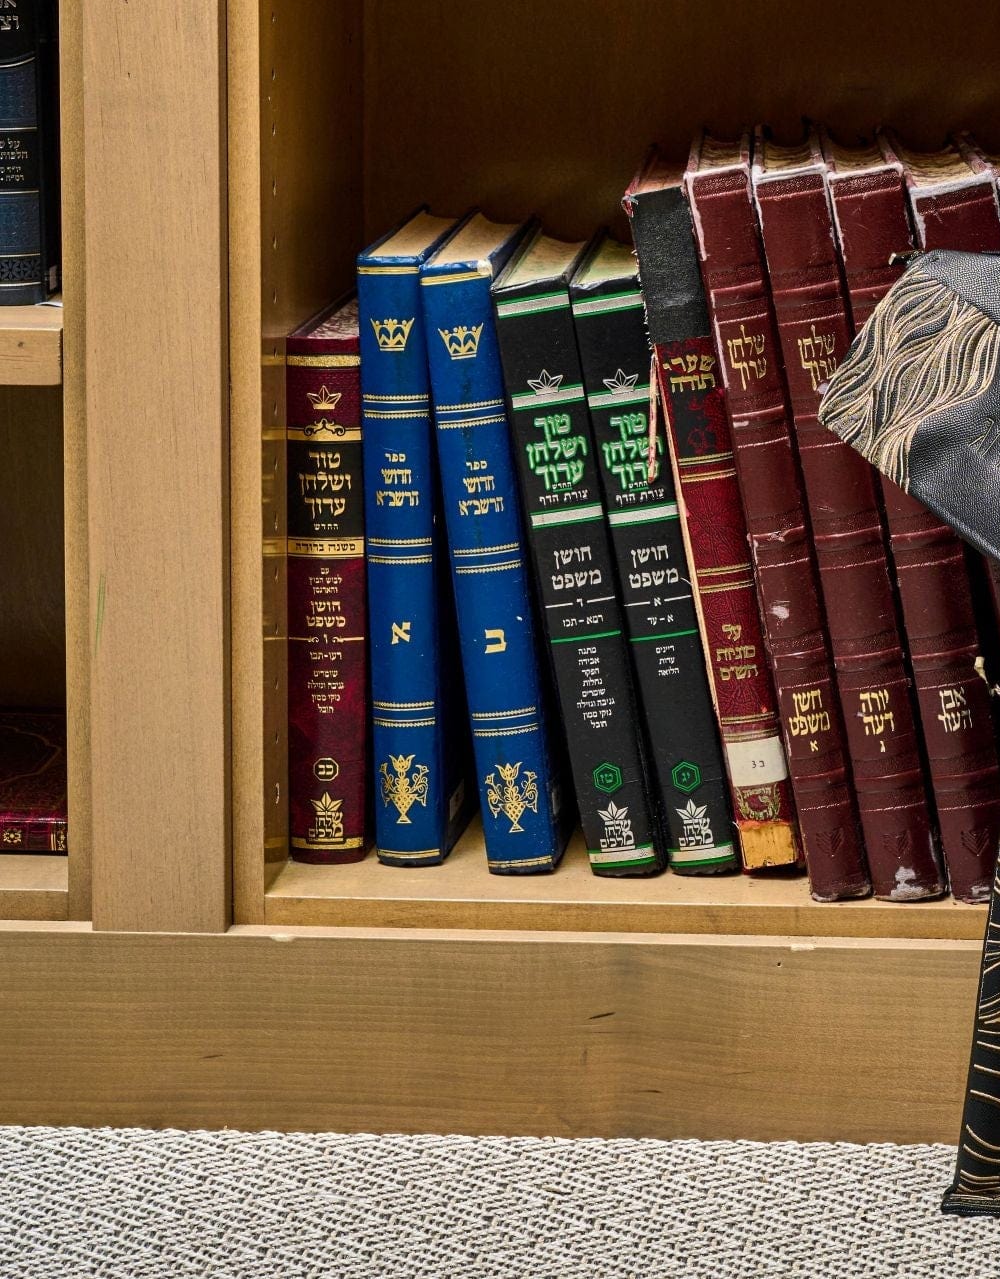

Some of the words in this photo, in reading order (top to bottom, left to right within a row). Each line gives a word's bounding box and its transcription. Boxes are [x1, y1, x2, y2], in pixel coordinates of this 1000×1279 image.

[727, 324, 765, 363] שלחן
[797, 324, 836, 363] שלחן
[662, 355, 715, 373] שערי
[534, 414, 575, 444] טור
[310, 453, 340, 468] טור
[385, 453, 405, 462] ספר
[526, 436, 587, 468] ושלחן
[466, 461, 487, 470] ספר
[535, 460, 584, 490] ערוך
[299, 472, 352, 495] ושלחן
[381, 469, 411, 484] חדושי
[463, 476, 495, 493] חדושי
[304, 498, 346, 519] ערוך
[295, 544, 324, 552] ברורה
[554, 546, 591, 569] חושן
[631, 545, 668, 568] חושן
[552, 570, 601, 590] משפט
[629, 568, 678, 588] משפט
[311, 601, 340, 614] חושן
[307, 616, 345, 627] משפט
[392, 622, 410, 644] א
[485, 629, 506, 654] ב
[582, 668, 599, 677] הפקר
[789, 689, 822, 721] חשן
[860, 689, 888, 712] יורה
[938, 687, 966, 719] אבן
[789, 709, 830, 736] משפט
[863, 712, 895, 735] דעה
[810, 740, 818, 752] א
[880, 740, 886, 753] ג
